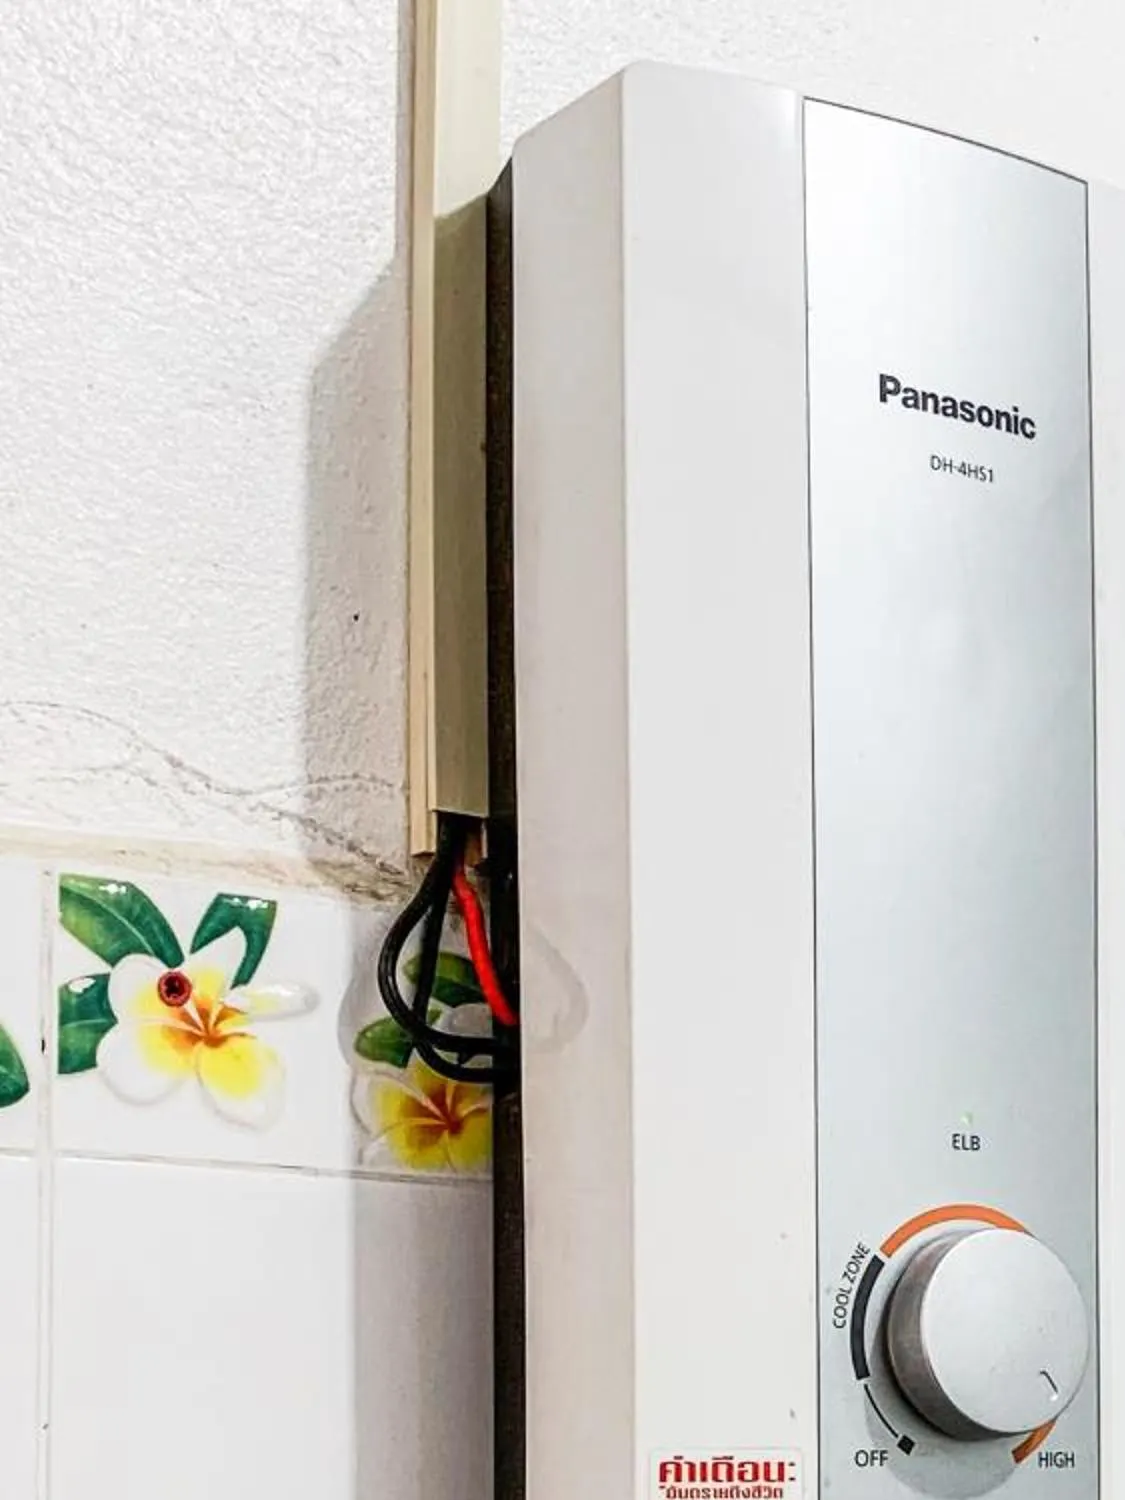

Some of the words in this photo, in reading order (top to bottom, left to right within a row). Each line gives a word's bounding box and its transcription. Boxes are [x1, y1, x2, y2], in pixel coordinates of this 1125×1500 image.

[878, 373, 1036, 440] Panasonic
[930, 454, 994, 483] DH-4HS1
[951, 1133, 981, 1151] ELB
[842, 1242, 870, 1283] ZONE
[832, 1287, 853, 1329] COOL
[854, 1450, 889, 1467] OFF
[1038, 1452, 1075, 1468] HIGH
